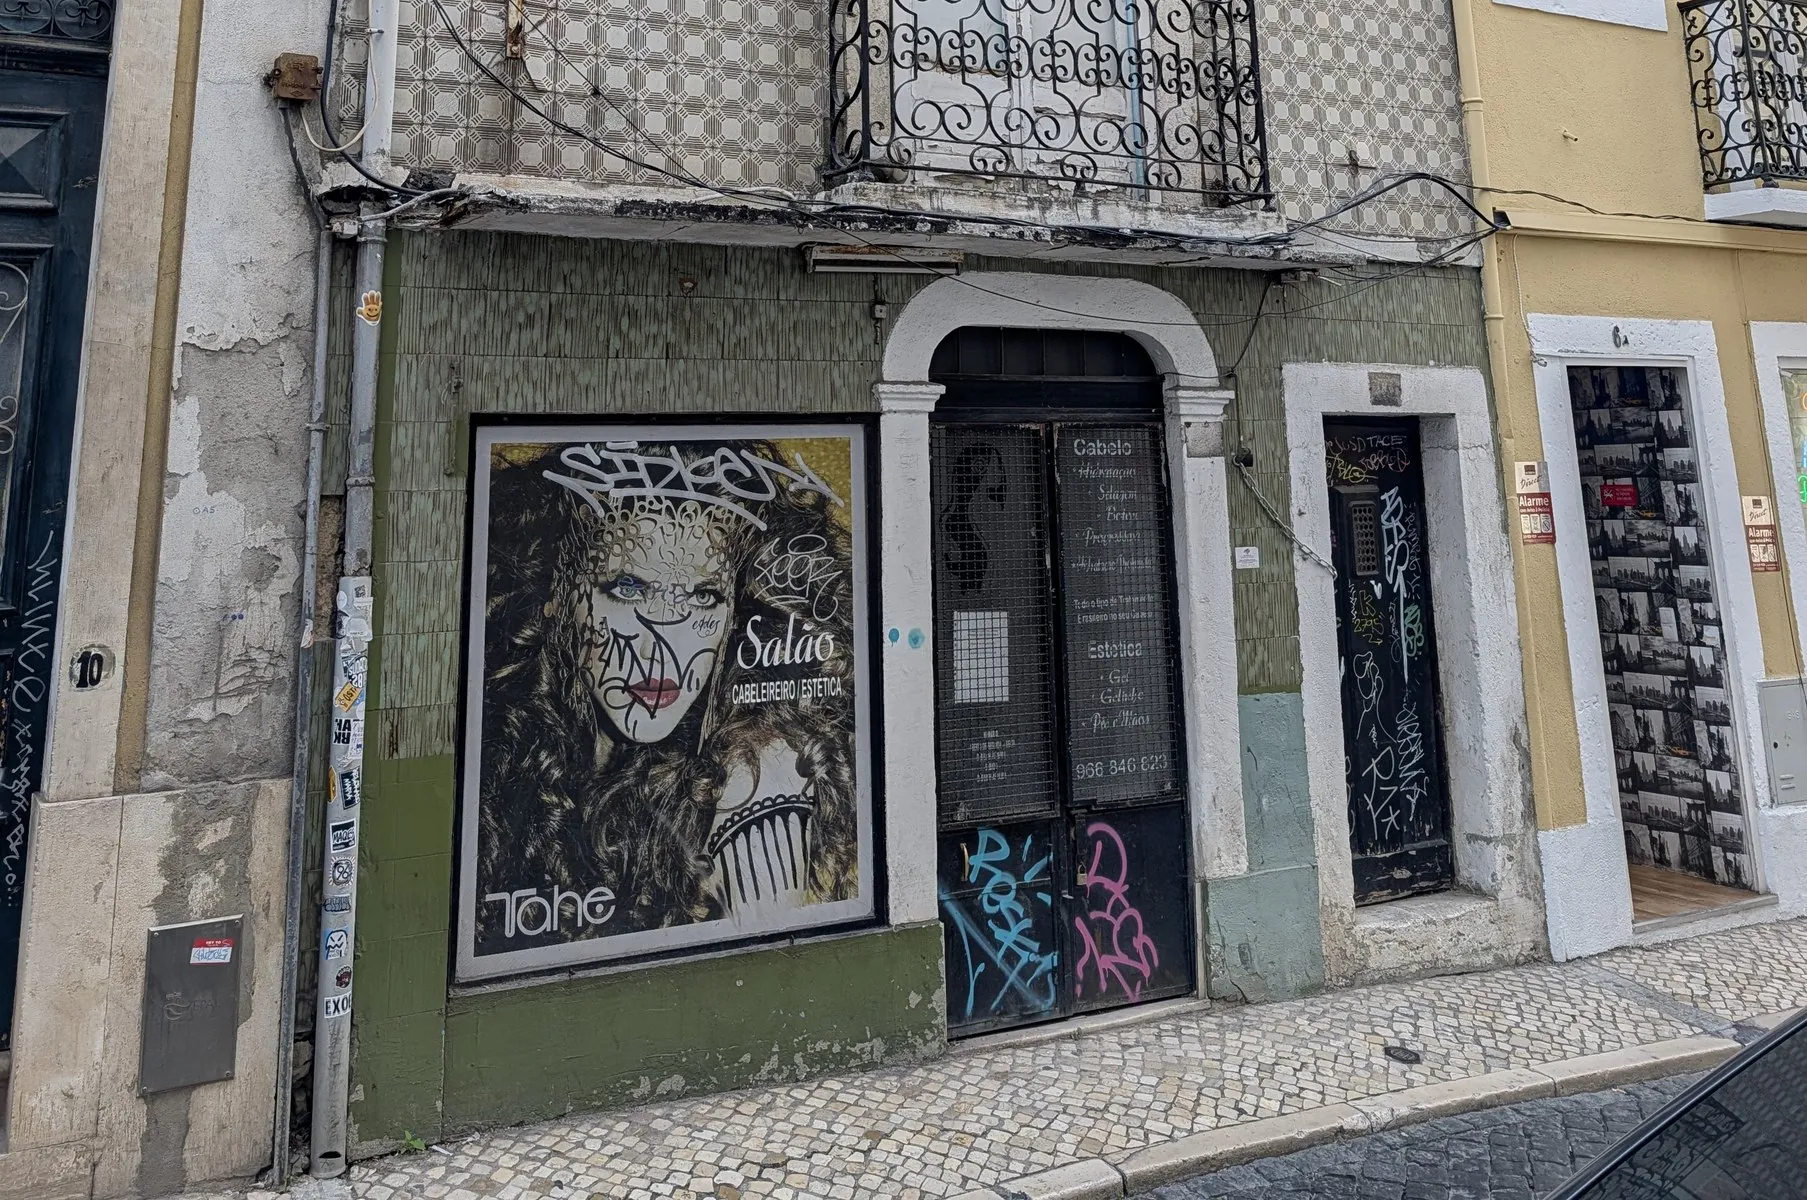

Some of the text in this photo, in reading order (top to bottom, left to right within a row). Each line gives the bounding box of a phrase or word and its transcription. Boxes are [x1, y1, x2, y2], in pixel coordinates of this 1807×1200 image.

[1073, 438, 1132, 456] Cabelo
[1519, 495, 1549, 507] Alarme
[736, 612, 835, 669] Salão
[76, 650, 102, 688] 10
[732, 681, 796, 705] CABELEIREIRO
[801, 674, 843, 700] ESTÉTICA
[485, 884, 617, 938] Tahe
